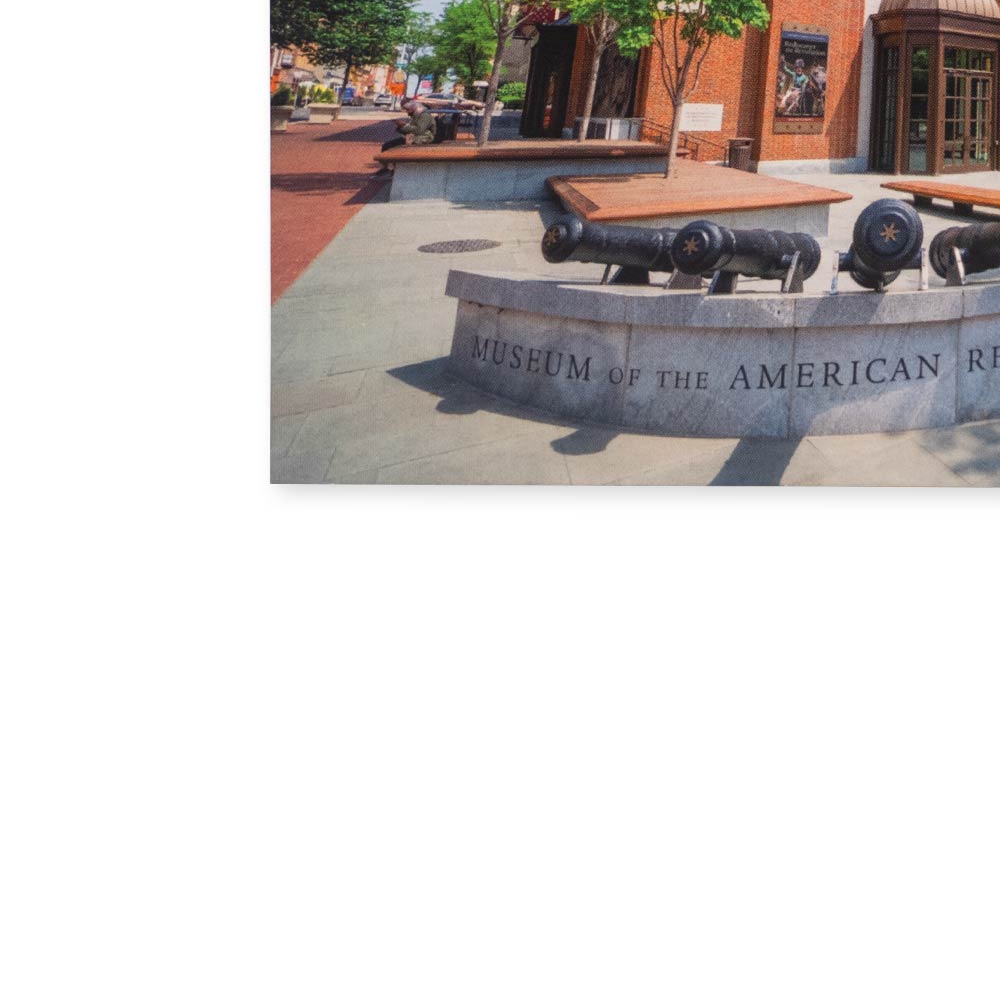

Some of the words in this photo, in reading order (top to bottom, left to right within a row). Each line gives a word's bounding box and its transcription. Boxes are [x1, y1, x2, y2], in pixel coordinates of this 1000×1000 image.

[470, 335, 593, 381] MUSEUM
[608, 367, 641, 387] OF
[656, 370, 710, 390] THE
[729, 353, 942, 391] AMERICAN
